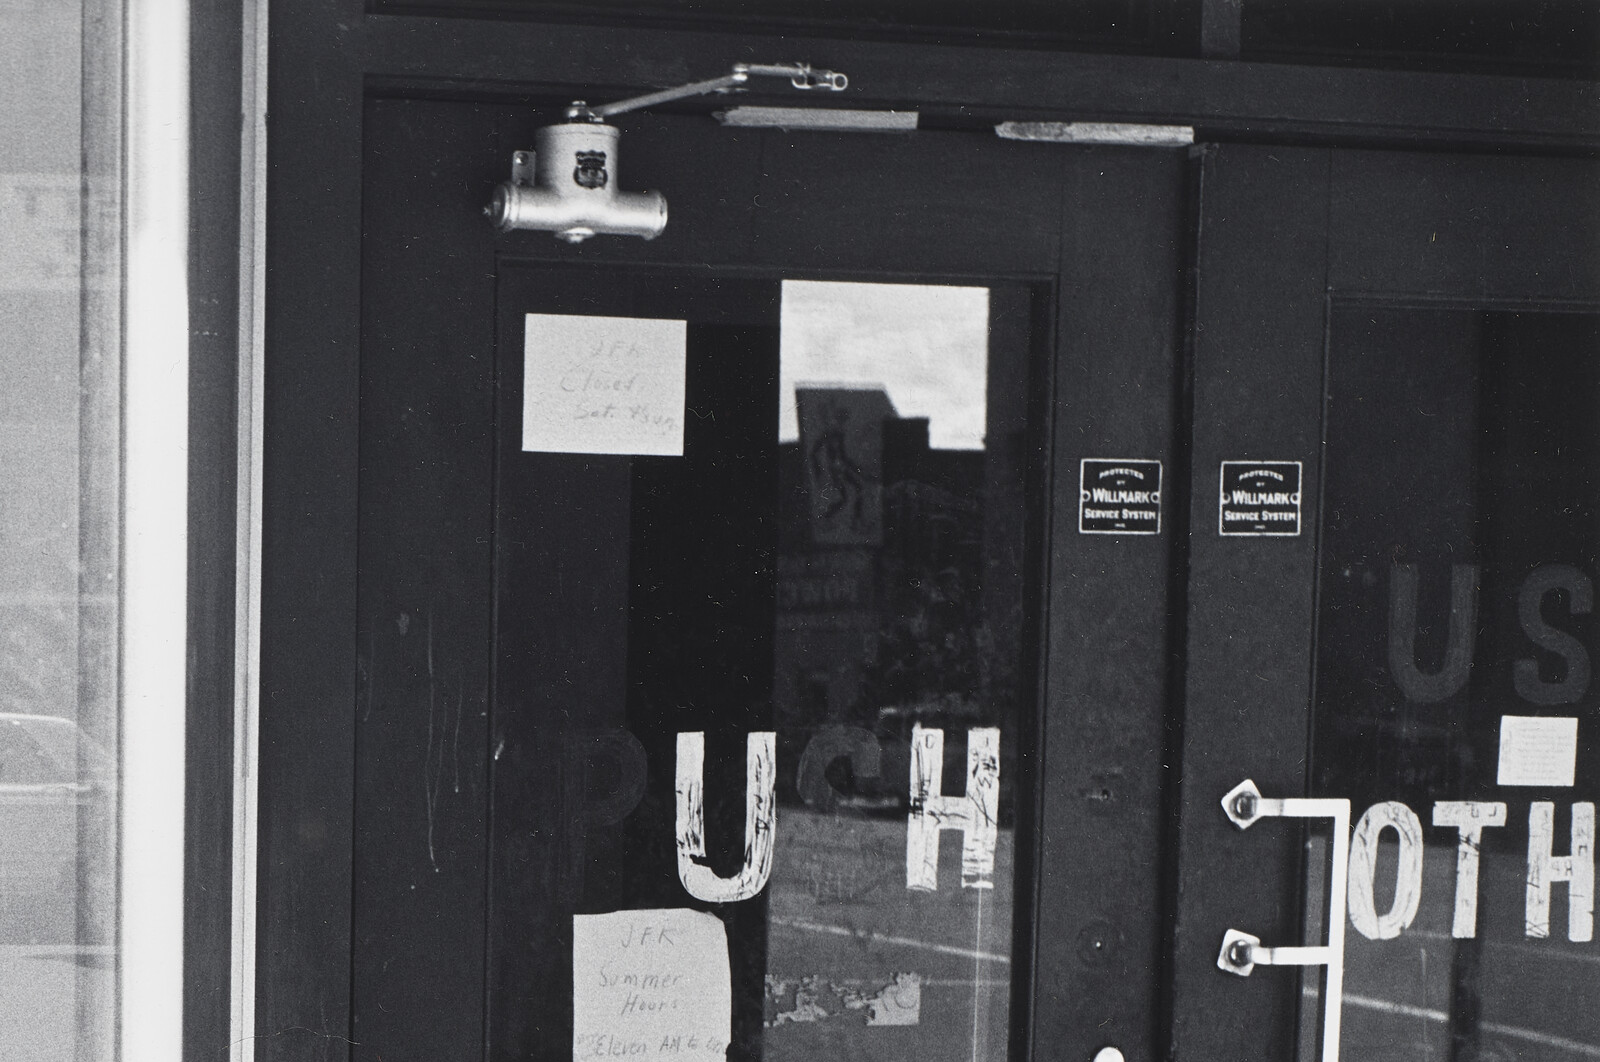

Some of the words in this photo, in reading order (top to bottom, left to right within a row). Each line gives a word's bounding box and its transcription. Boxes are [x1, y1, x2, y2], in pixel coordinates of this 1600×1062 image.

[1098, 468, 1144, 480] PROTECTED
[1238, 469, 1284, 482] PROTECTED
[1092, 487, 1150, 504] WILLMARK
[1232, 489, 1290, 506] WILLMARK
[1084, 508, 1121, 520] SERVICE
[1122, 508, 1157, 520] SYSTEM
[1224, 510, 1261, 521] SERVICE
[1262, 510, 1297, 521] SYSTEM
[620, 923, 676, 949] JFK
[599, 963, 684, 990] Summer
[621, 991, 679, 1017] Hours
[594, 1034, 647, 1056] Eleven
